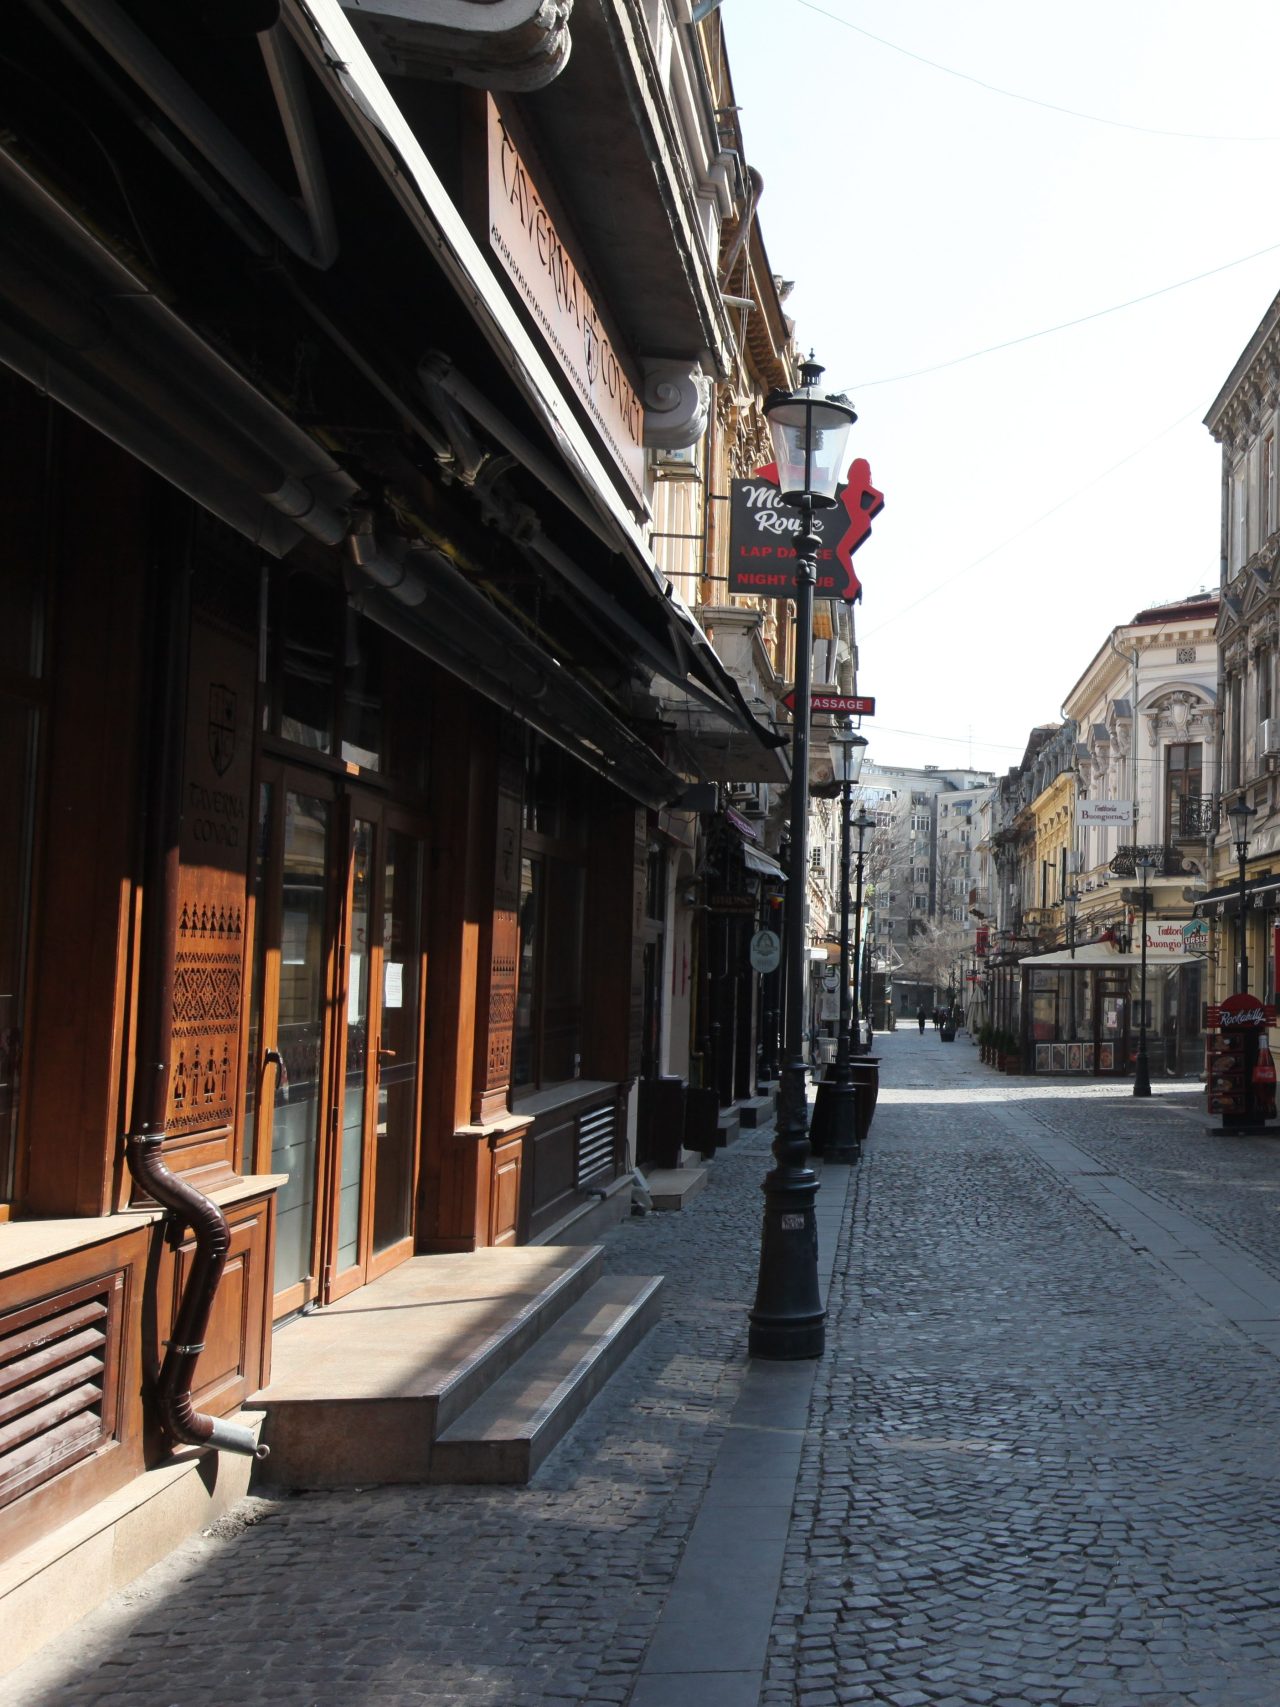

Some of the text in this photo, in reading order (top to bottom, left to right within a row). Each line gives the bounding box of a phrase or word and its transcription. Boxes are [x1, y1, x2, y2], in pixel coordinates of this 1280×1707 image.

[754, 510, 825, 536] Roue
[739, 546, 833, 560] LAP DACE
[737, 573, 834, 588] NIGHT CUB
[810, 698, 864, 710] ASSAGE
[1156, 925, 1183, 936] Trattori
[1219, 1008, 1266, 1026] Rockabilly
